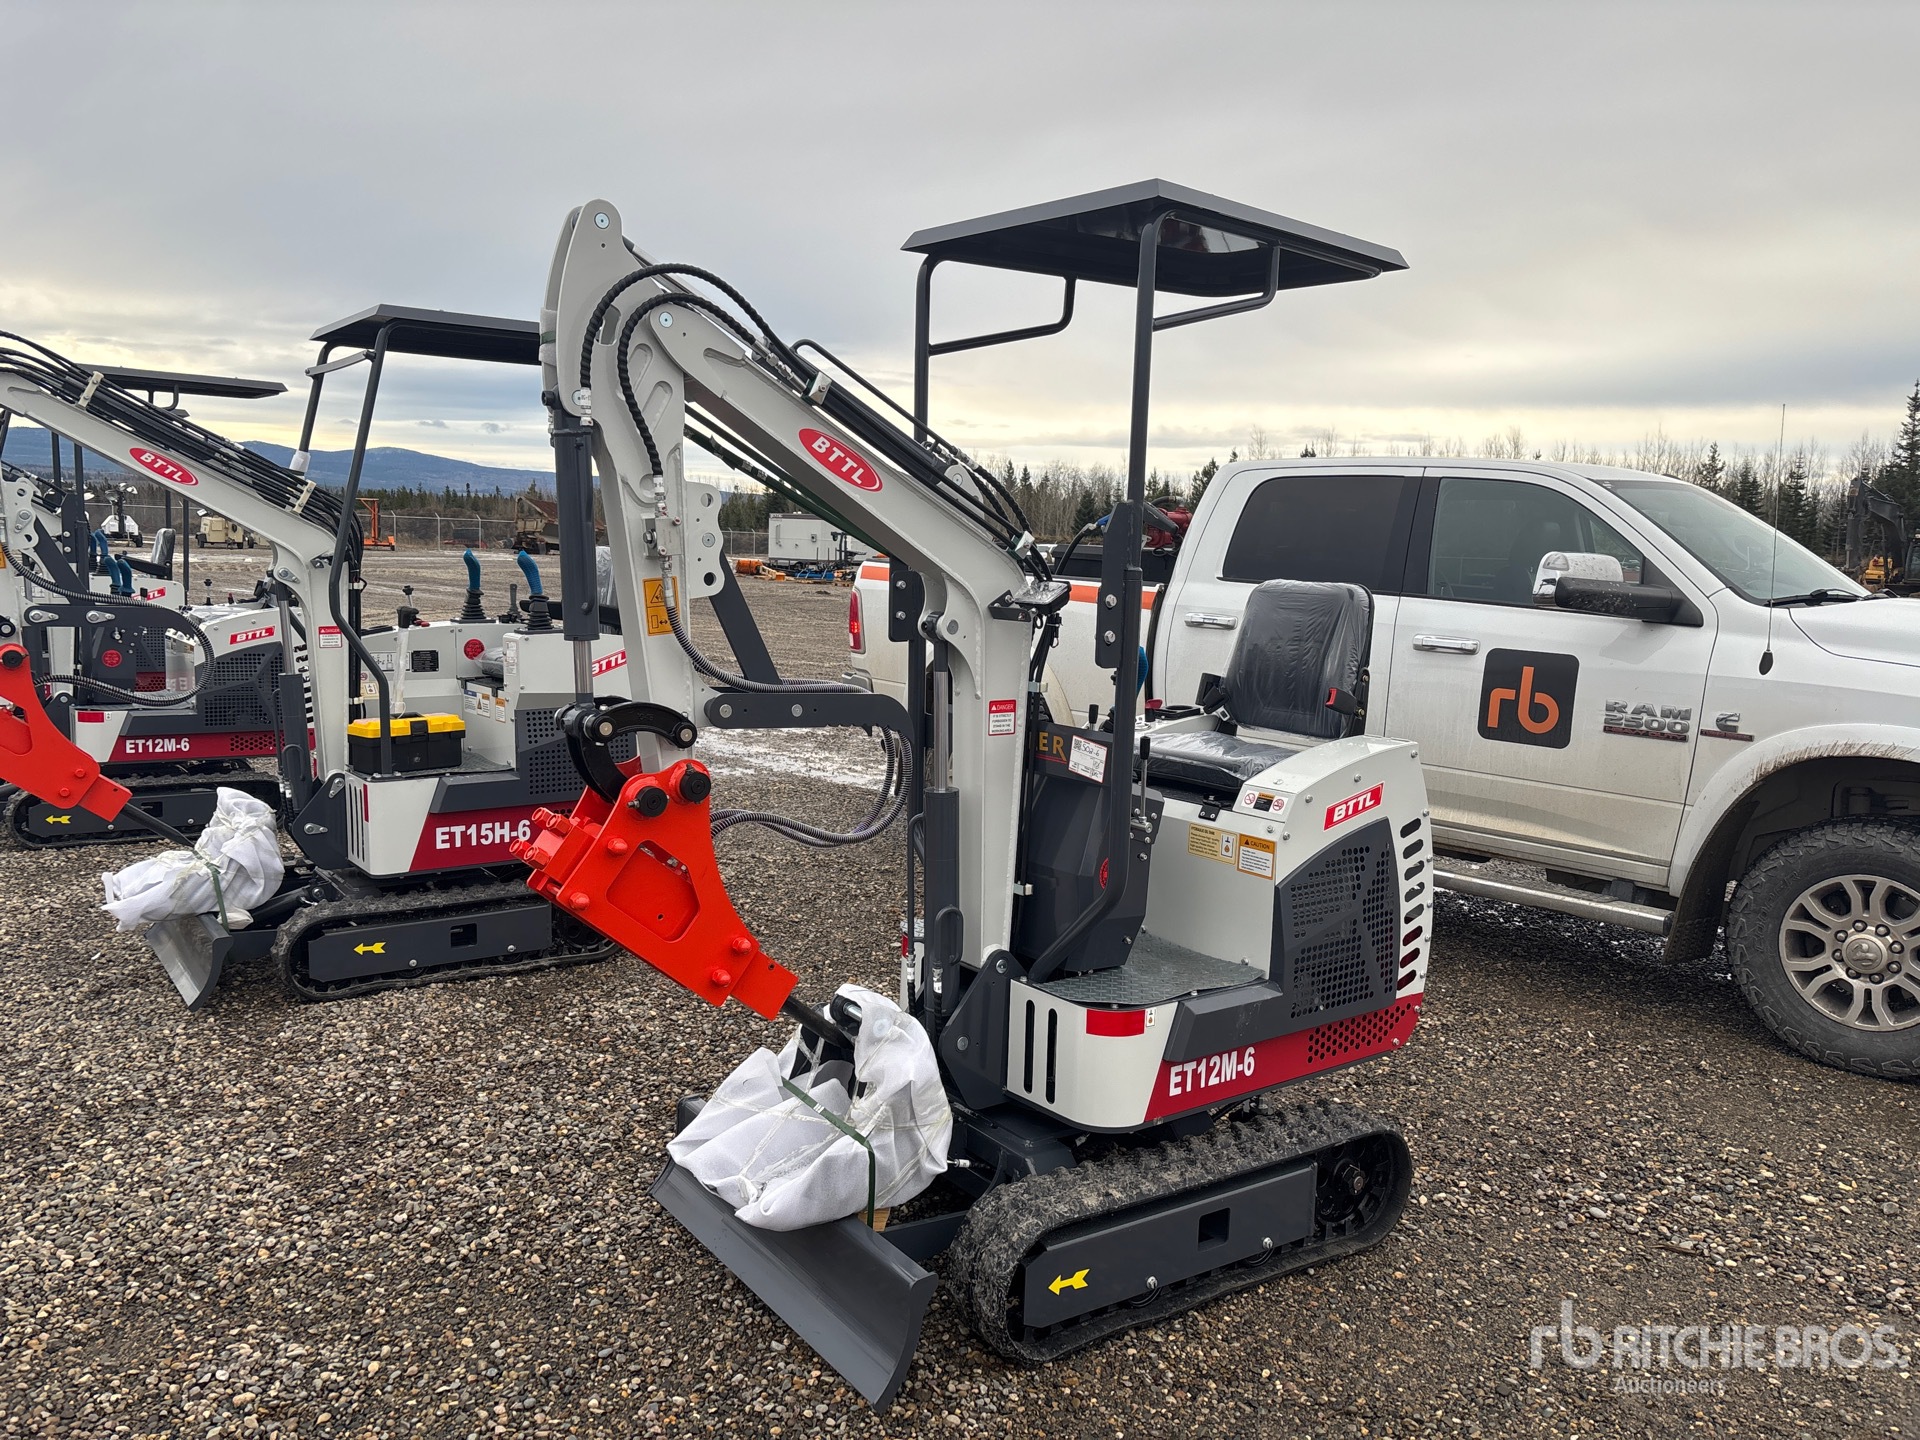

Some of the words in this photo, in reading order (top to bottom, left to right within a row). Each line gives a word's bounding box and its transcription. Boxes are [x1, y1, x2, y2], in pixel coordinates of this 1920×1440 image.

[139, 452, 183, 482] BTTL
[811, 435, 865, 485] BTTL
[235, 629, 270, 642] BTTL
[1486, 665, 1560, 735] rb
[1605, 699, 1692, 721] RAM
[1603, 711, 1691, 735] 2500
[125, 737, 190, 754] ET12M-6
[1332, 792, 1376, 823] BTTL
[435, 819, 532, 850] ET15H-6
[1250, 840, 1270, 850] CAUTION
[1168, 1045, 1256, 1098] ET12M-6
